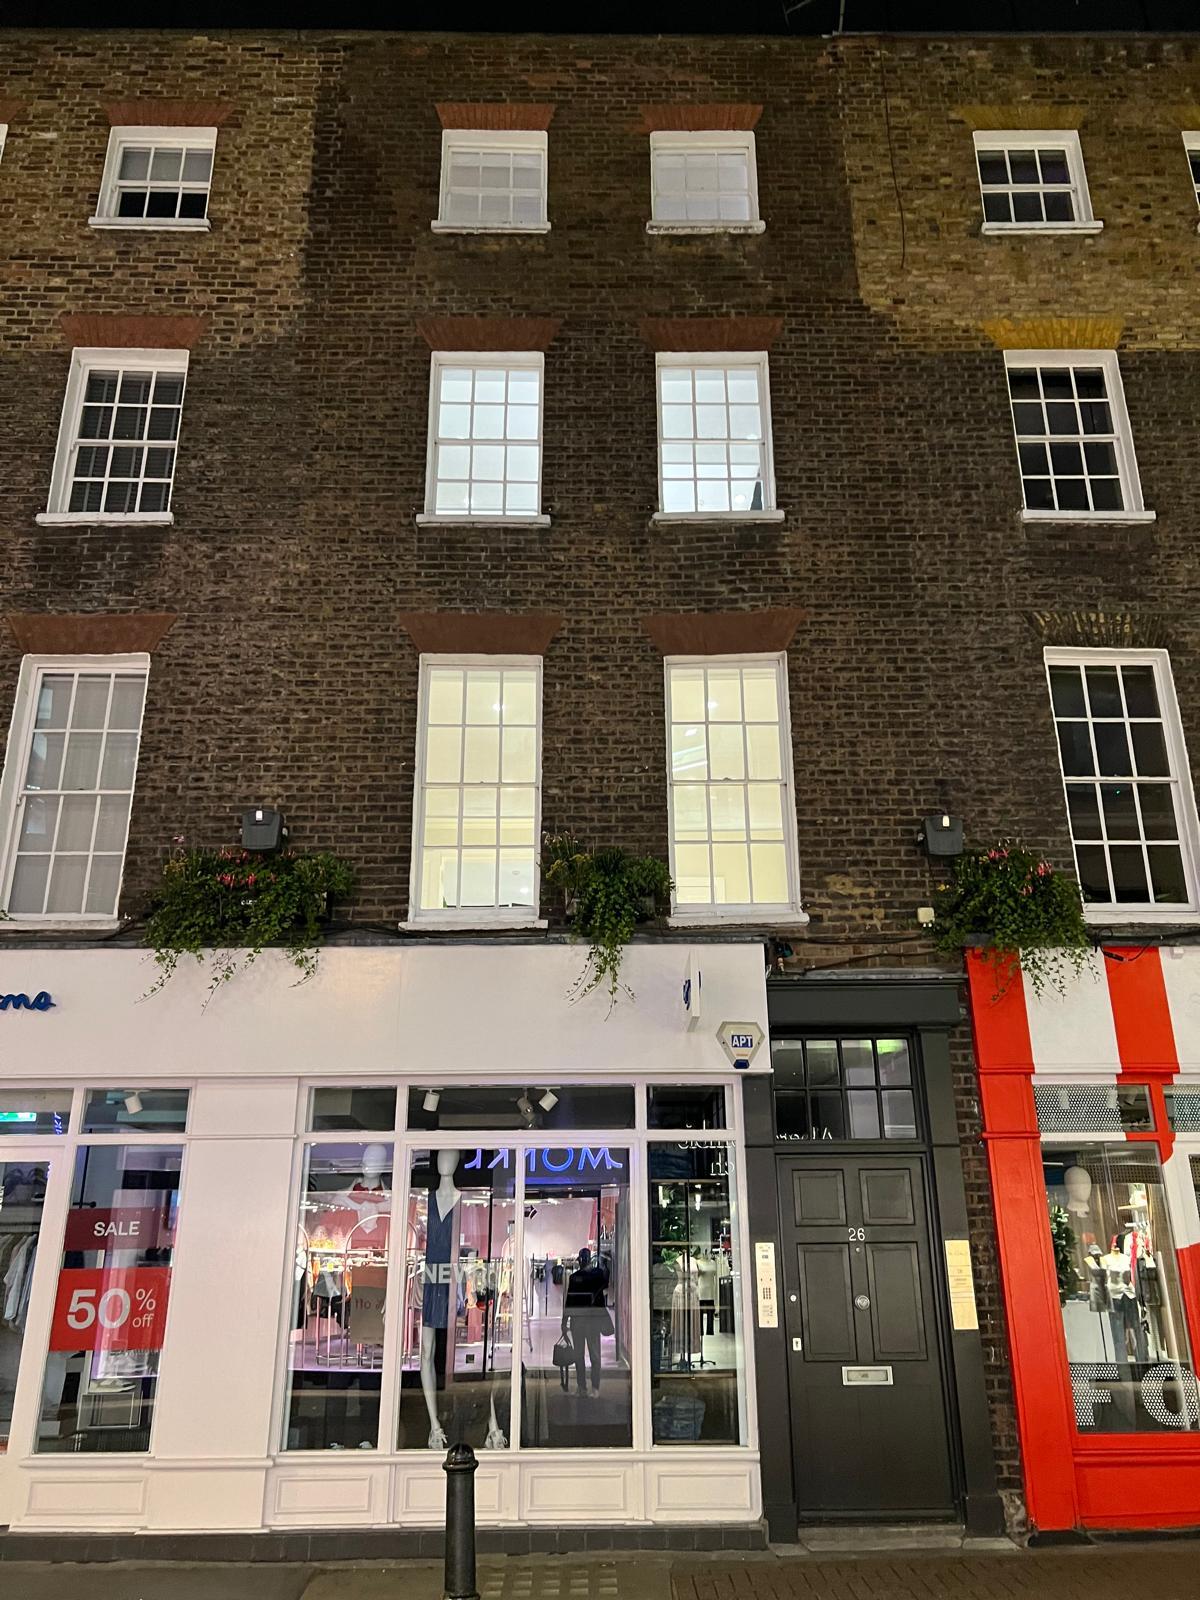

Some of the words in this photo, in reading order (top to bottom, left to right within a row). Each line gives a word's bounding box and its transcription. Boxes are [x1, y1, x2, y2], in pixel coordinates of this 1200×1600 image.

[732, 1035, 753, 1048] APT
[93, 1221, 140, 1236] SALE
[848, 1227, 866, 1242] 26
[67, 1288, 131, 1329] 50
[132, 1313, 155, 1328] off
